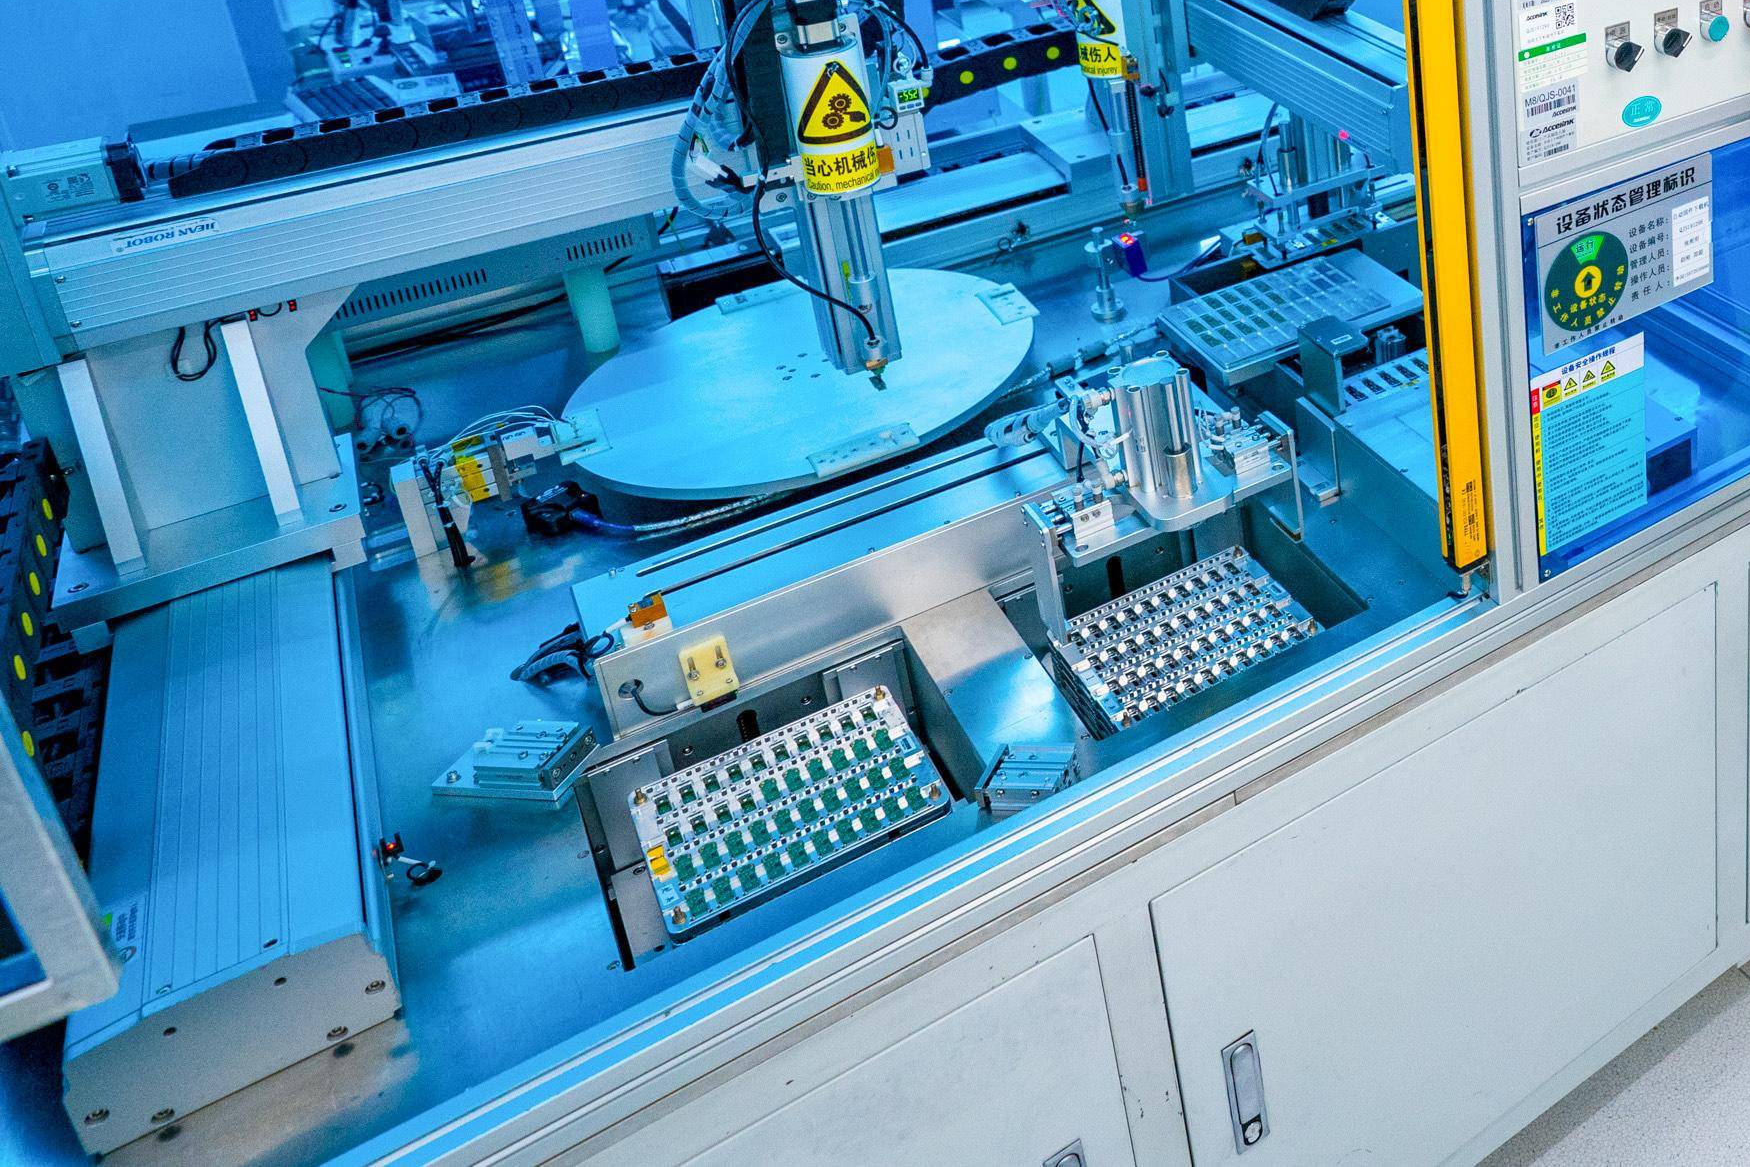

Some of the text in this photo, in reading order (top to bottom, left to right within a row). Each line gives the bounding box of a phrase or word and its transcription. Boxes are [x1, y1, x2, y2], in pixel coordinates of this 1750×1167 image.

[1524, 84, 1576, 108] M8/QJS-0041
[1542, 117, 1575, 134] Accelink
[1556, 167, 1696, 234] 设备状态管理标识
[124, 221, 216, 249] JIEAN ROBOT
[1629, 217, 1669, 238] 设备名称：
[1561, 346, 1616, 375] 设备安全操作规程
